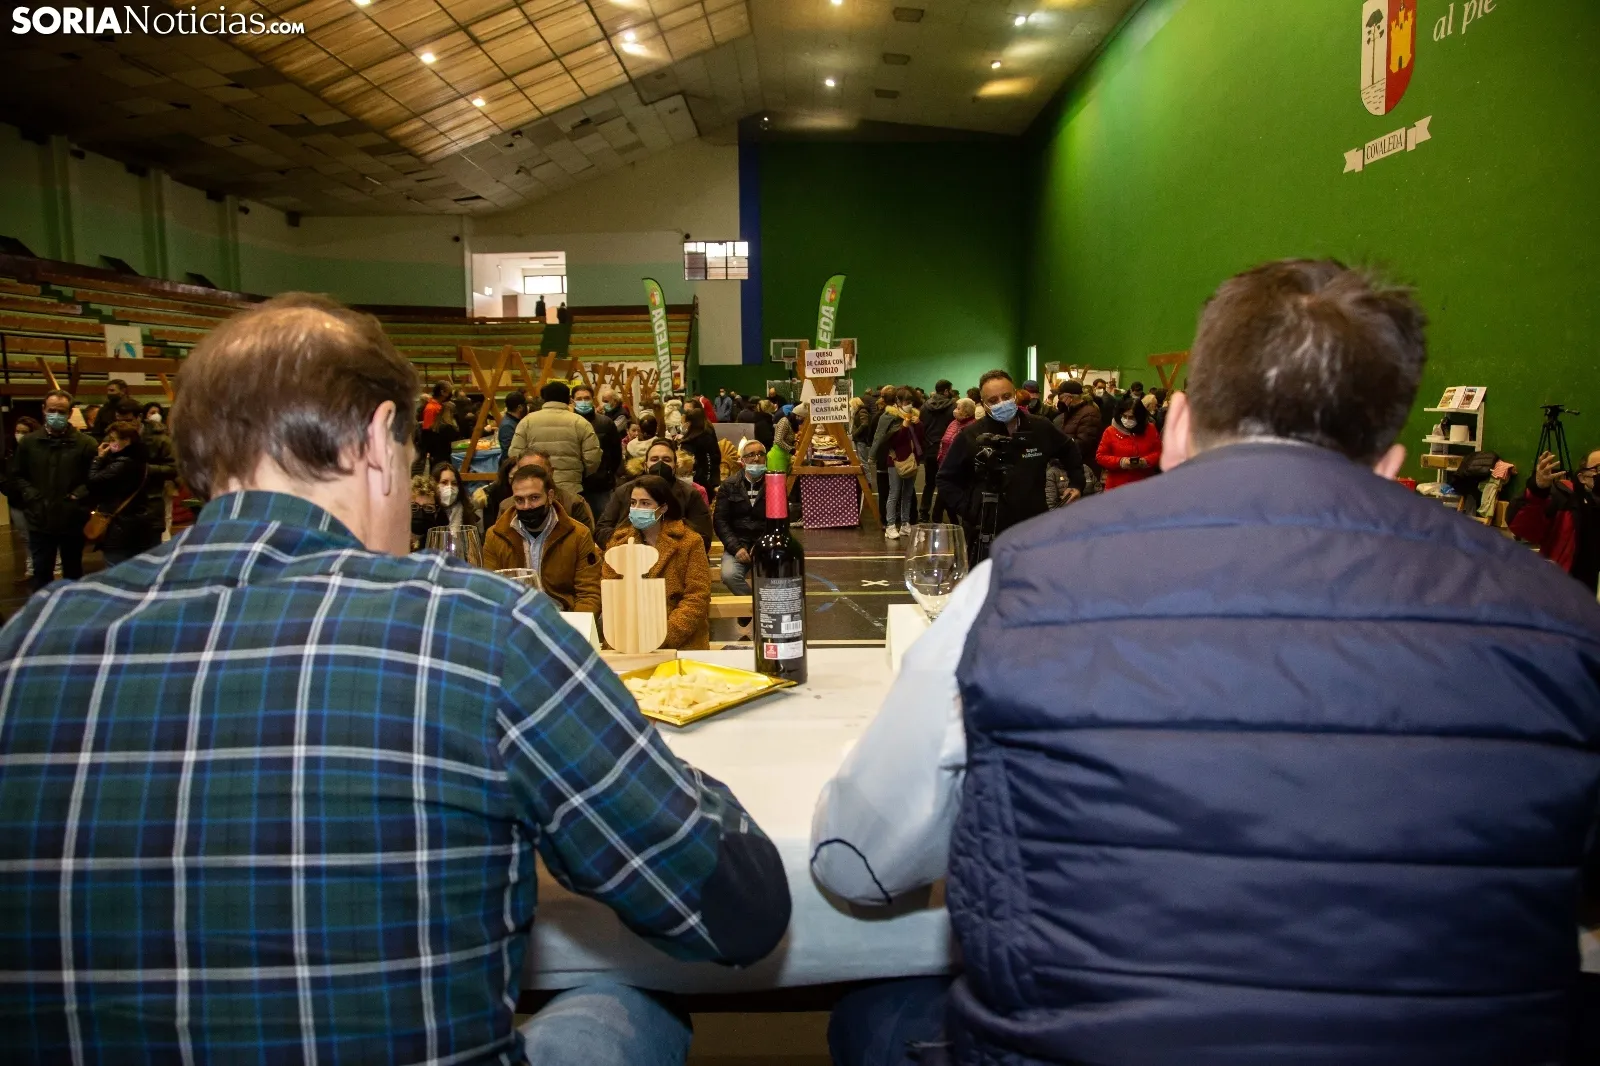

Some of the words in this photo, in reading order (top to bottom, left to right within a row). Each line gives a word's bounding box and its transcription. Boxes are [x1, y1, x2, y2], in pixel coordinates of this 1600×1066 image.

[1433, 3, 1454, 41] al
[1366, 133, 1403, 160] COVALEDA
[811, 366, 839, 375] CHORIZO
